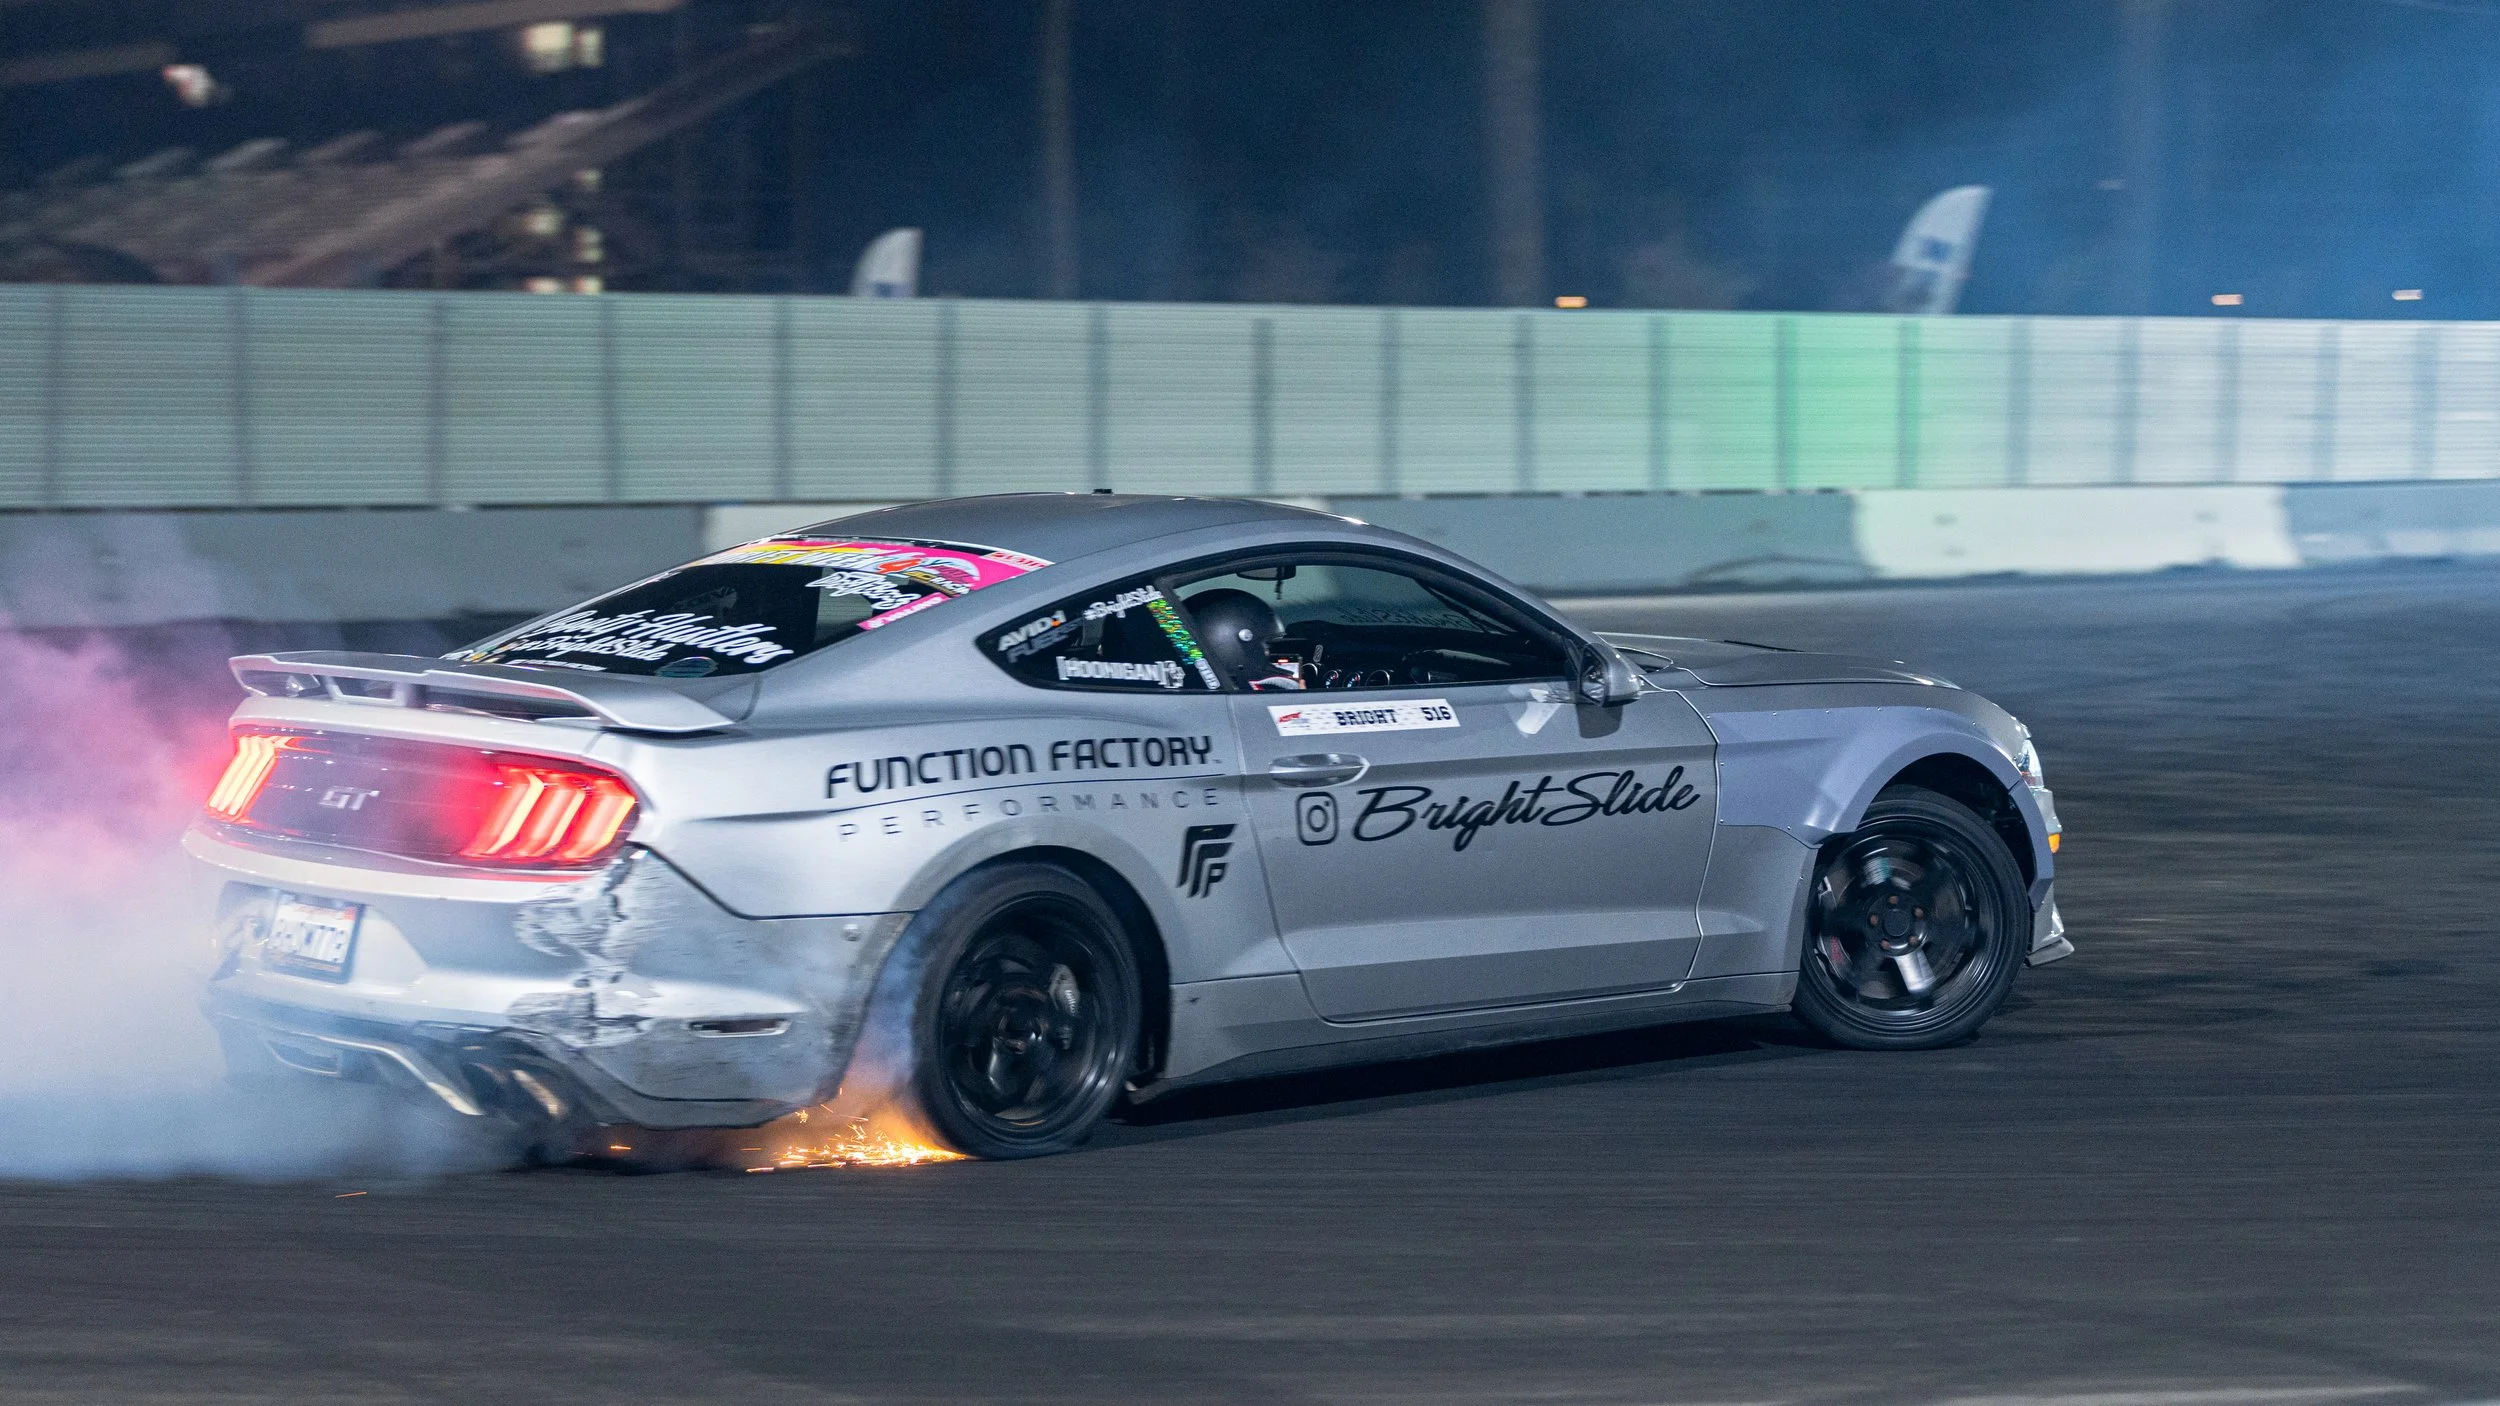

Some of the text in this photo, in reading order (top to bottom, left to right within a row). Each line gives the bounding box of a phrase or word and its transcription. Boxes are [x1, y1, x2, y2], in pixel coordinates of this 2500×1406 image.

[1333, 706, 1452, 726] BRIGHT 516
[825, 736, 1213, 799] FUNCTION FACTORY
[318, 786, 379, 811] GT
[838, 788, 1220, 842] PERFORMANCE
[1352, 765, 1701, 852] BrightSlide
